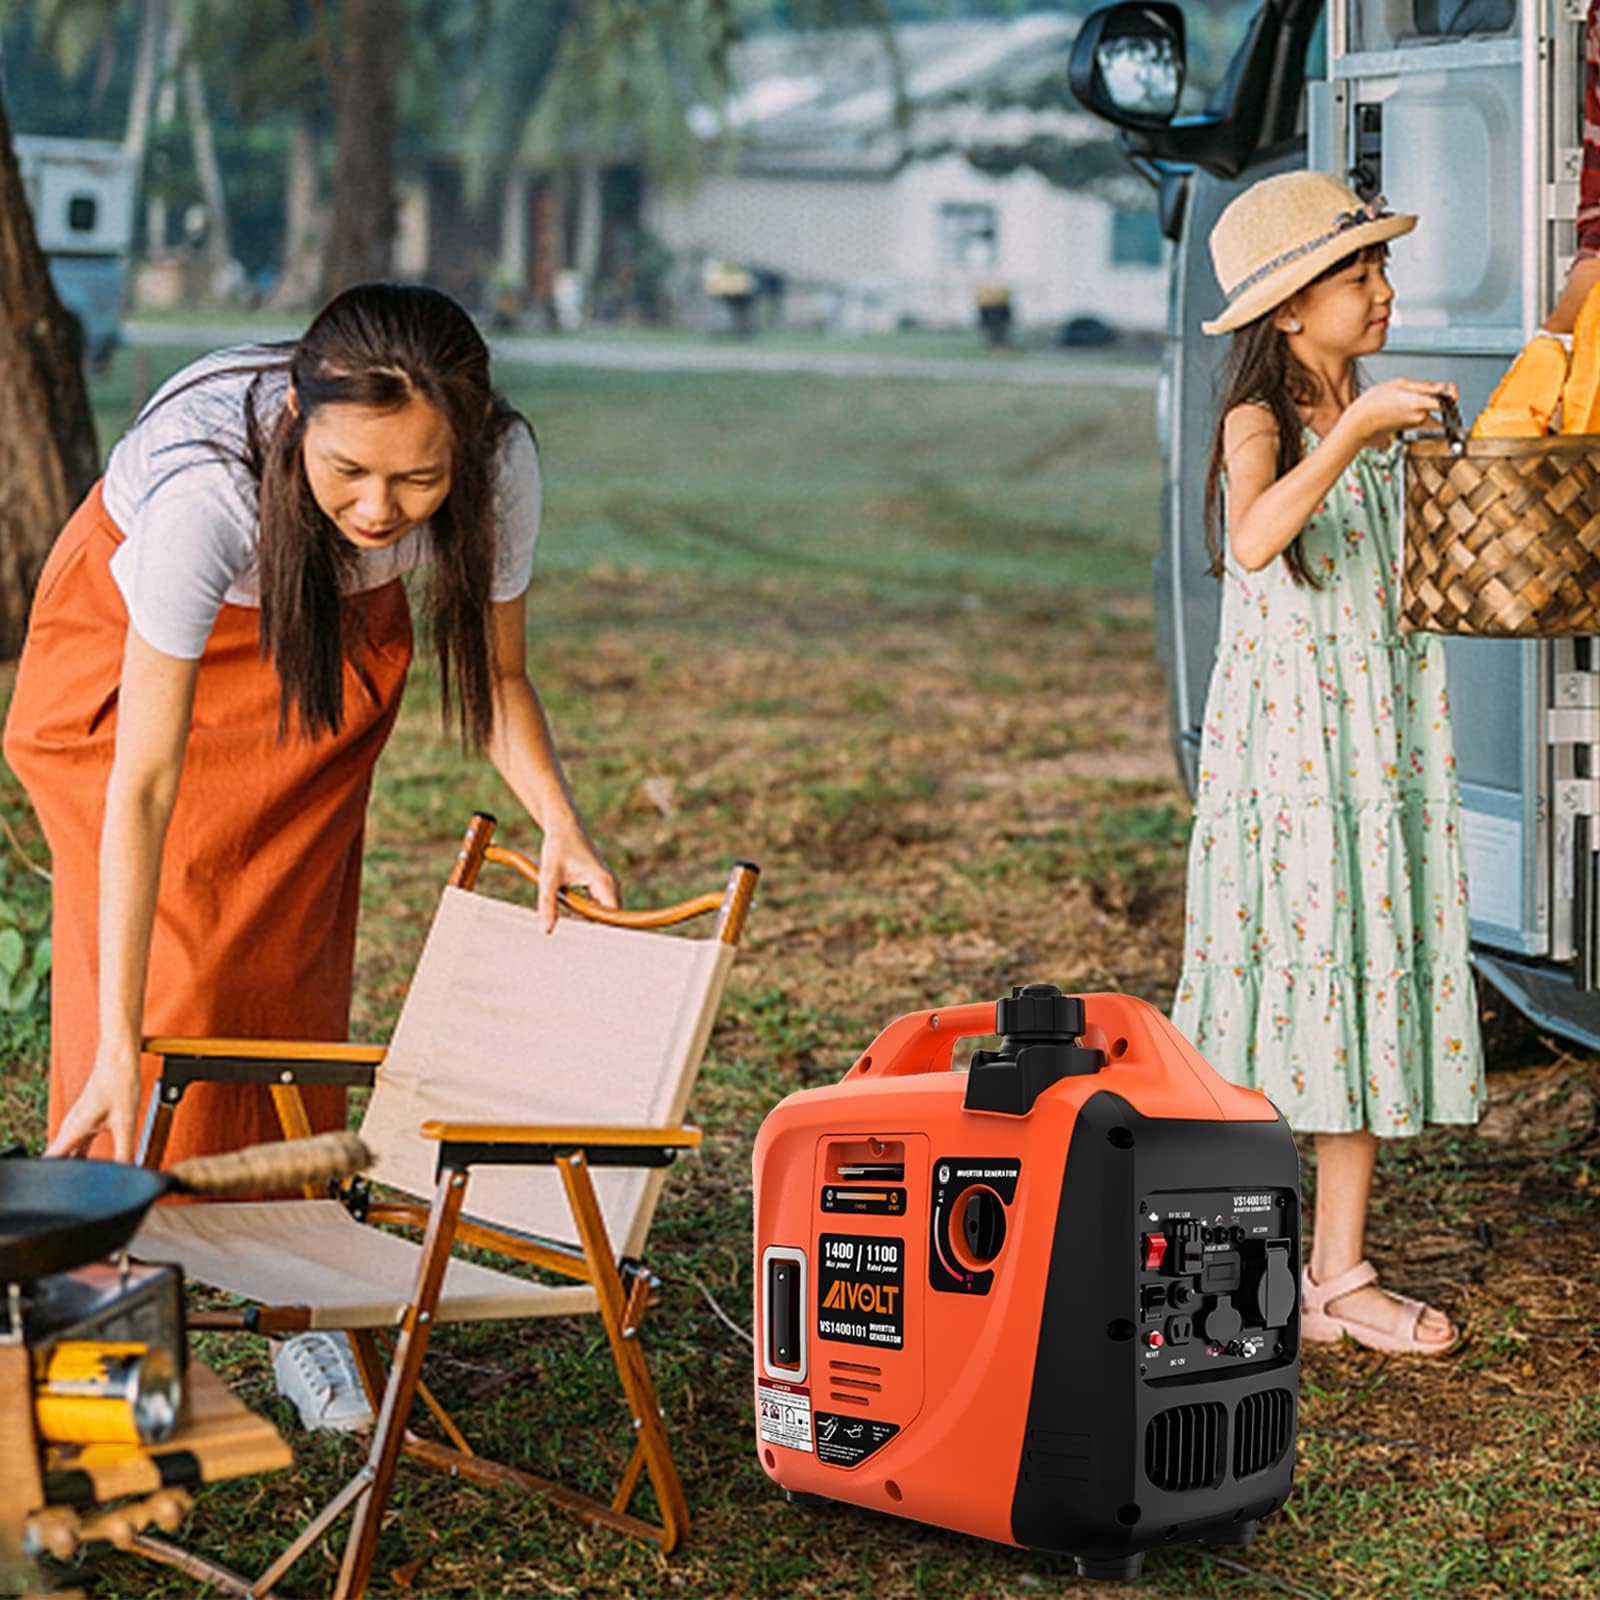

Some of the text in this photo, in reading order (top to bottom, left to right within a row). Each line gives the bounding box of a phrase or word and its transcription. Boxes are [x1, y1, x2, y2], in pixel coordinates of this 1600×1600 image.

[957, 1169, 1018, 1178] INVERTER GENERATOR
[1233, 1195, 1272, 1206] VS1400101
[825, 1241, 854, 1259] 1400
[866, 1243, 898, 1263] 1100
[819, 1319, 867, 1338] VS1400101
[869, 1322, 896, 1333] INVERTER
[869, 1332, 902, 1344] GENERATOR
